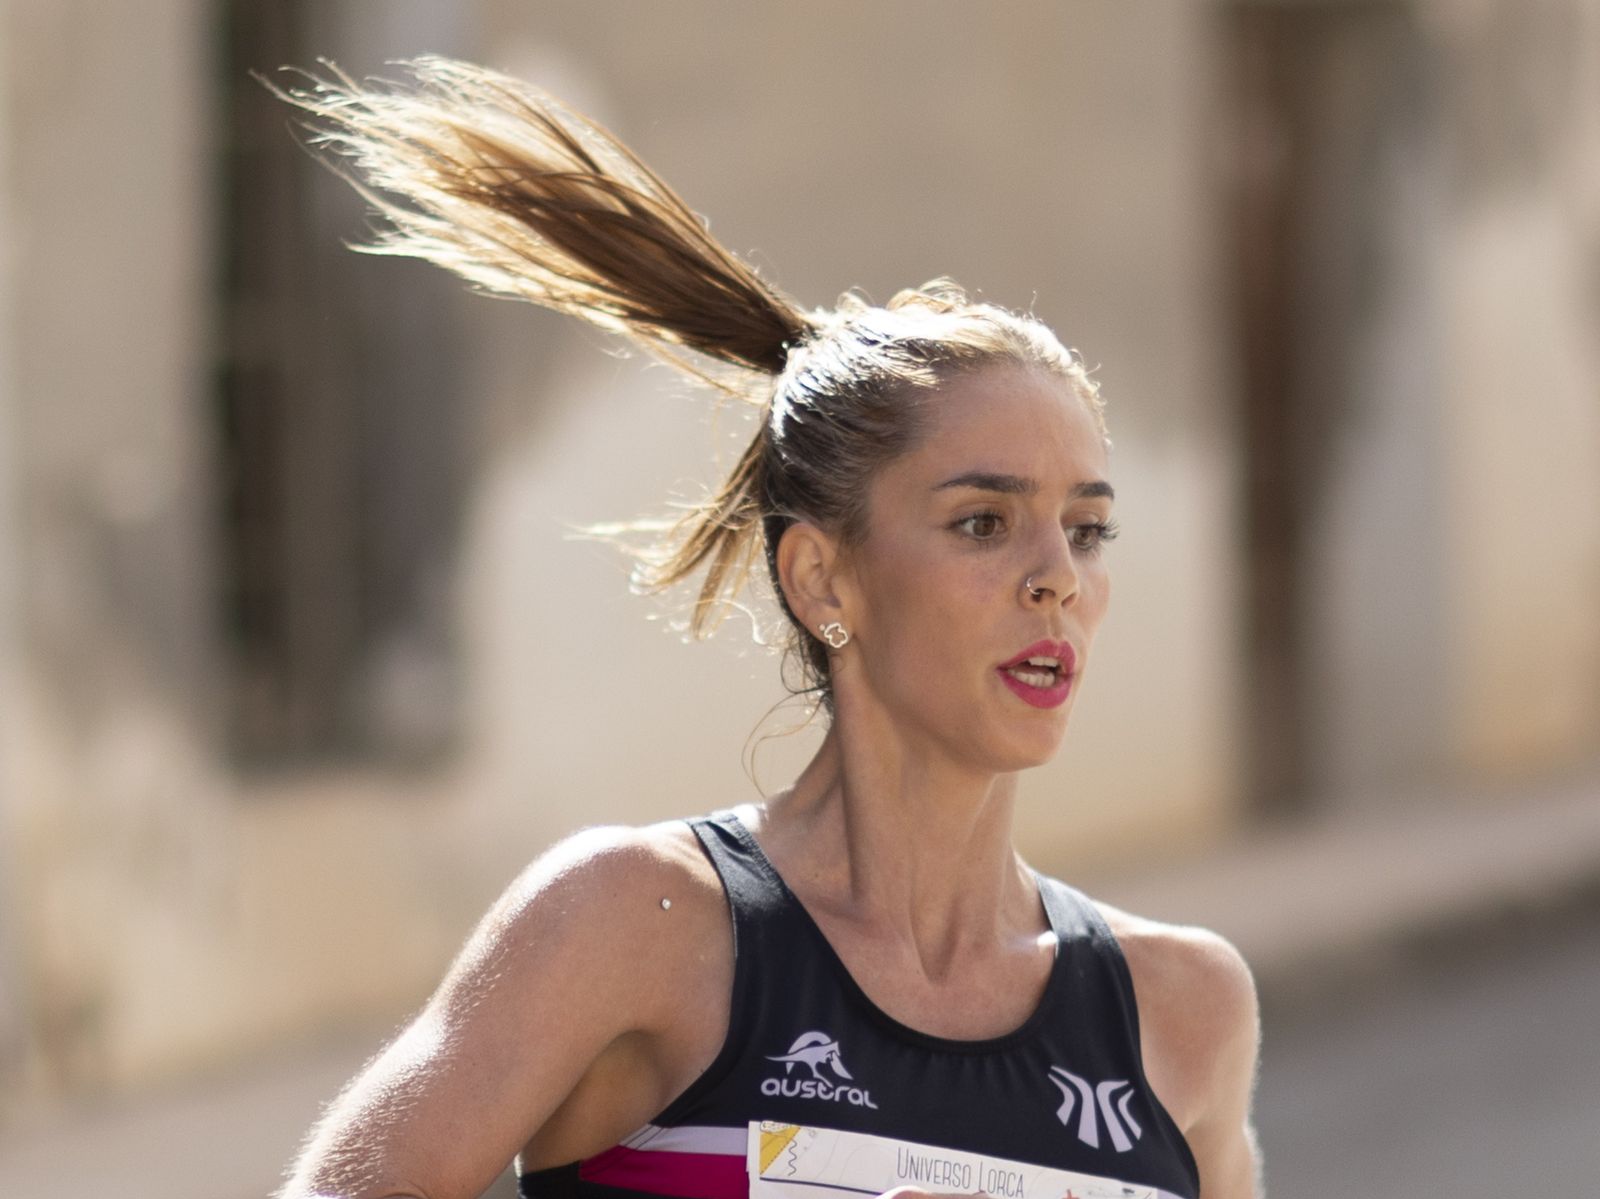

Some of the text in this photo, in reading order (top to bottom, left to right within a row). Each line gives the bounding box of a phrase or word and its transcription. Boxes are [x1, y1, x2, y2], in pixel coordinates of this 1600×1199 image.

[761, 1078, 878, 1109] austral
[896, 1147, 1024, 1199] UNIVERSO LORCA
